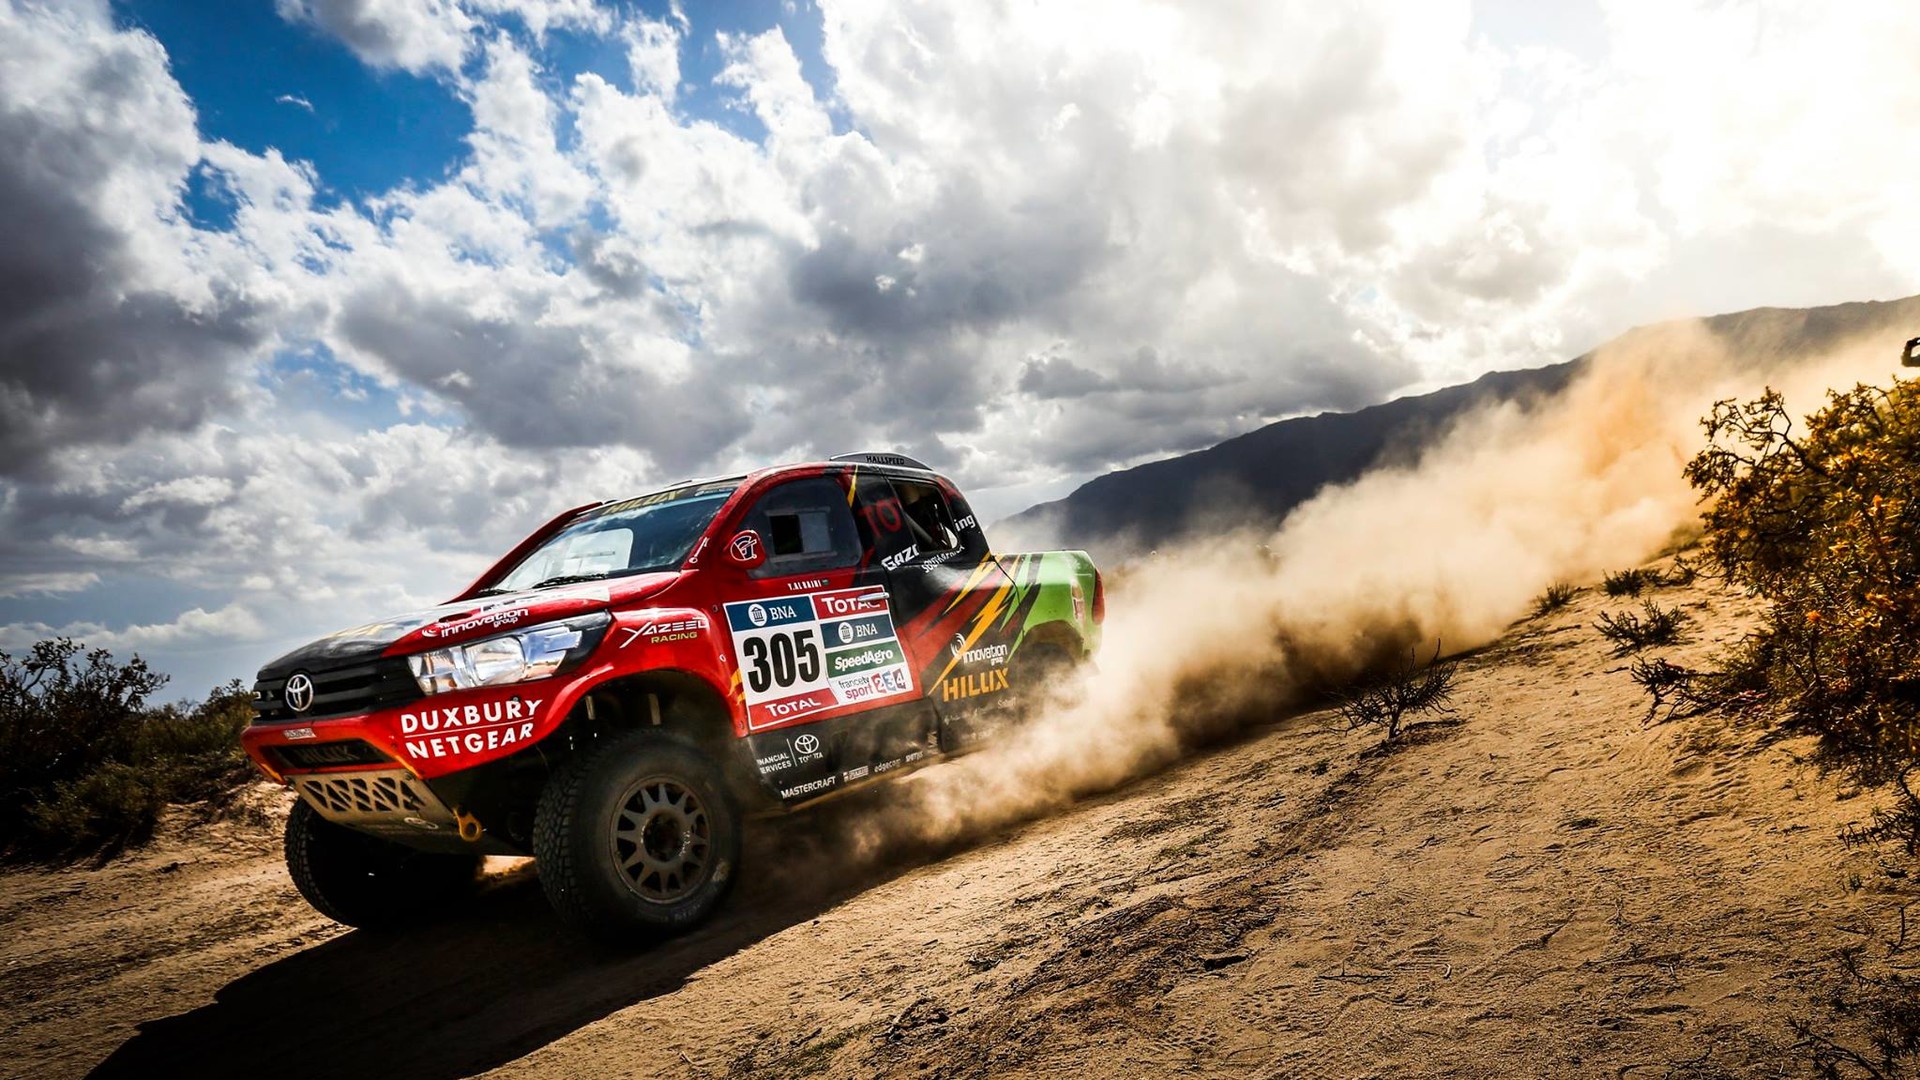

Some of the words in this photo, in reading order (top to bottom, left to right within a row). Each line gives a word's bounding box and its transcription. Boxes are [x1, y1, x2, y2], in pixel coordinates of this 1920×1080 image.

[441, 608, 529, 637] innovation
[493, 616, 519, 629] group
[769, 605, 797, 621] BNA
[619, 616, 710, 649] YAZEED
[651, 631, 698, 644] RACING
[856, 623, 878, 638] BNA
[743, 629, 820, 693] 305
[834, 649, 894, 671] SpeedAgro
[963, 643, 1008, 664] innovation
[845, 683, 873, 700] sport
[943, 667, 1009, 702] HILUX
[401, 700, 543, 734] DUXBURY
[765, 697, 822, 717] TOTAL
[405, 723, 535, 759] NETGEAR
[798, 752, 823, 764] TOTA
[781, 776, 836, 799] MASTERCRAFT
